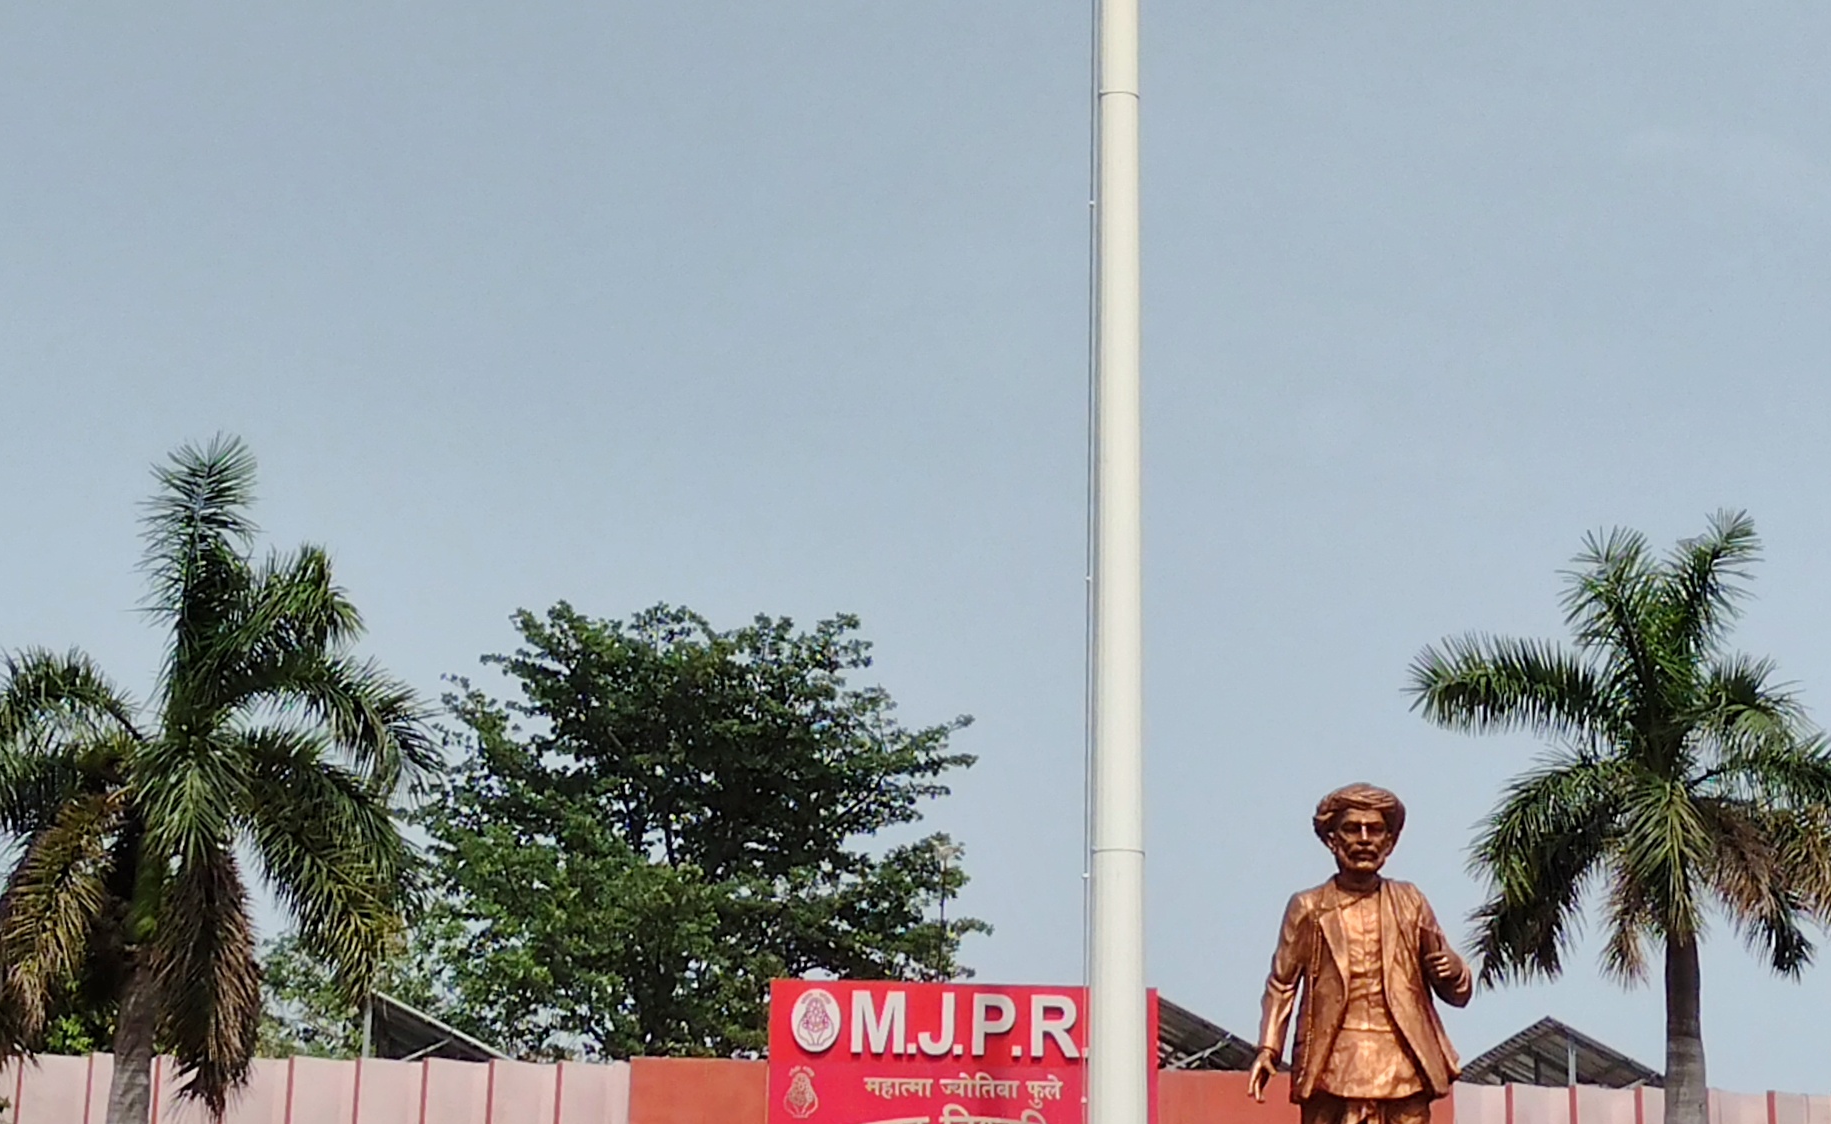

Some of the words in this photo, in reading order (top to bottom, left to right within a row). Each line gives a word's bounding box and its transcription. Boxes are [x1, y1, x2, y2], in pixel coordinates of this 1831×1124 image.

[850, 989, 1090, 1058] M.J.P.R.
[862, 1077, 933, 1099] महात्मा
[1025, 1074, 1063, 1109] फुले
